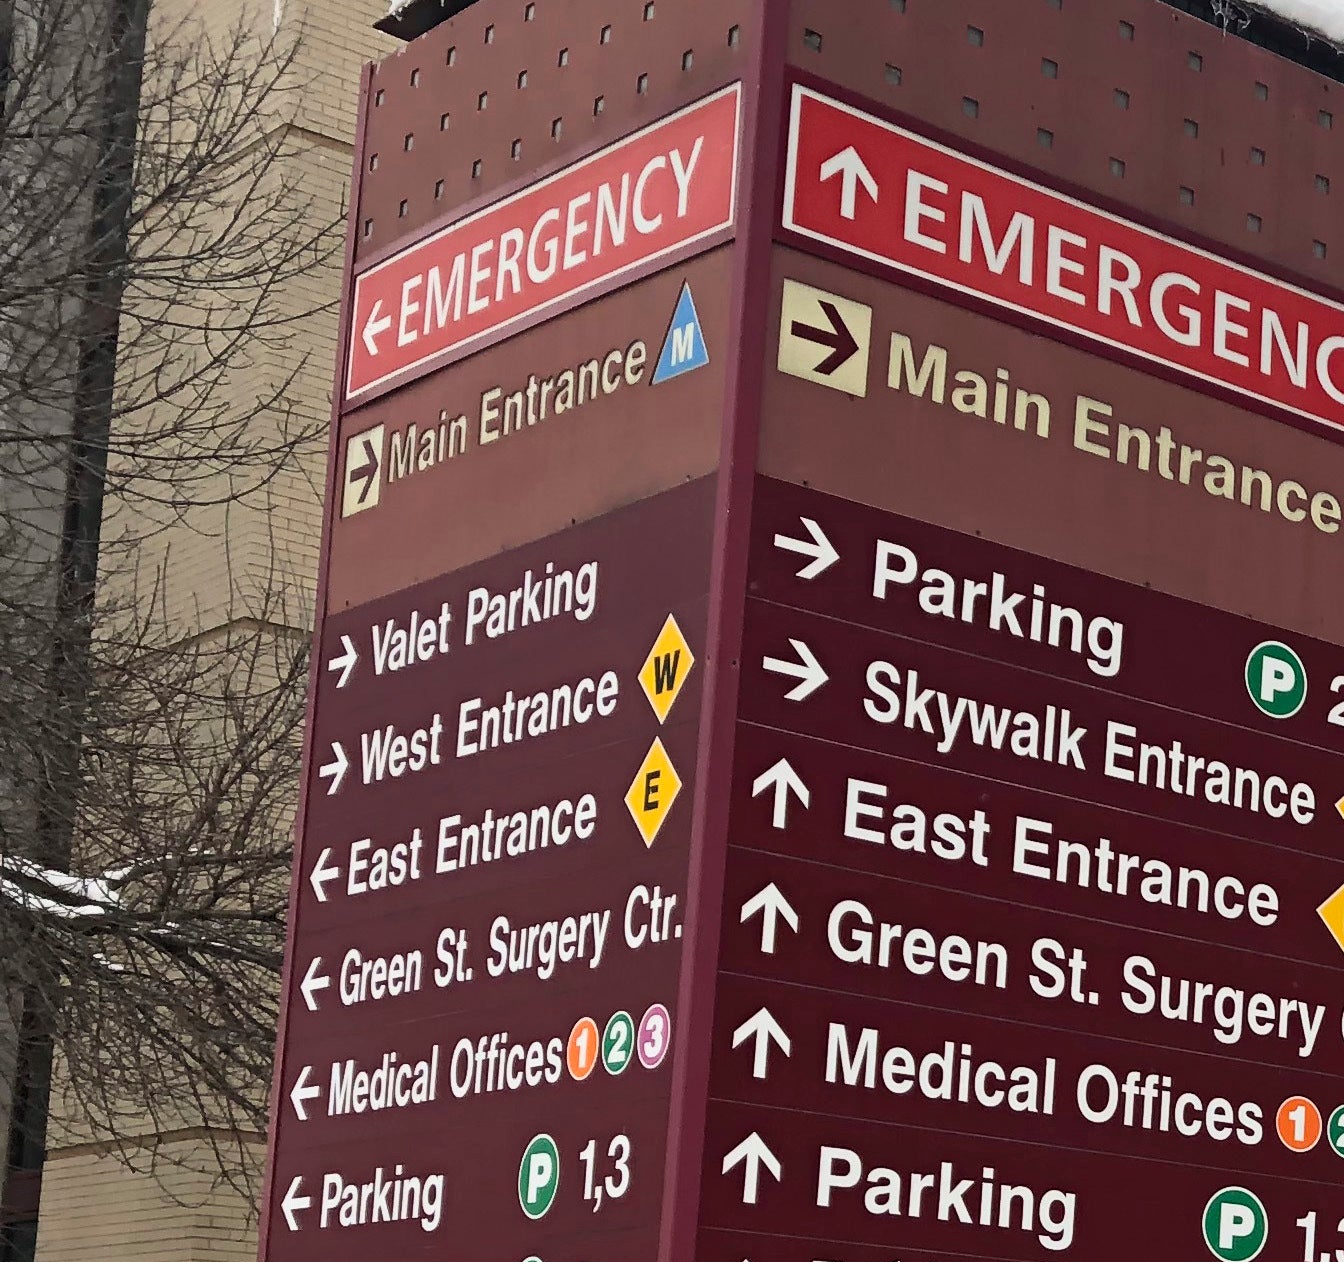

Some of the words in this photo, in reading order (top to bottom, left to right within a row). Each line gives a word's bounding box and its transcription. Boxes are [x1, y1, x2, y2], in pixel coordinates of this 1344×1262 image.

[397, 136, 704, 346] EMERGENCY
[388, 409, 467, 483] Main
[479, 339, 647, 445] Entrance
[671, 322, 693, 367] M
[887, 331, 1051, 439] Main
[1073, 393, 1342, 533] Entrance
[371, 602, 452, 675] Valet
[465, 561, 598, 646] Parking
[872, 539, 1124, 678] Parking
[1260, 654, 1294, 702] P
[361, 713, 442, 784] West
[456, 671, 618, 758] Entrance
[654, 649, 680, 695] W
[863, 661, 1088, 770] Skywalk
[1104, 721, 1316, 824] Entrance
[347, 828, 422, 896] East
[436, 793, 597, 874] Entrance
[643, 770, 660, 812] E
[843, 778, 990, 867] East
[1012, 816, 1279, 926] Entrance
[340, 949, 422, 1006] Green
[434, 927, 472, 987] St.
[486, 908, 611, 979] Surgery
[624, 885, 682, 949] Ctr.
[828, 900, 1008, 989] Green
[1029, 938, 1099, 1005] St.
[1121, 955, 1326, 1058] Surgery
[327, 1044, 439, 1116] Medical
[450, 1032, 563, 1099] Offices
[575, 1028, 589, 1069] 1
[609, 1023, 627, 1064] 2
[644, 1014, 663, 1056] 3
[825, 1022, 1056, 1115] Medical
[1078, 1064, 1264, 1145] Offices
[1288, 1106, 1309, 1141] 1
[319, 1165, 444, 1232] Parking
[528, 1153, 550, 1203] P
[578, 1134, 630, 1213] 1,3
[816, 1146, 1076, 1251] Parking
[1218, 1203, 1253, 1249] P
